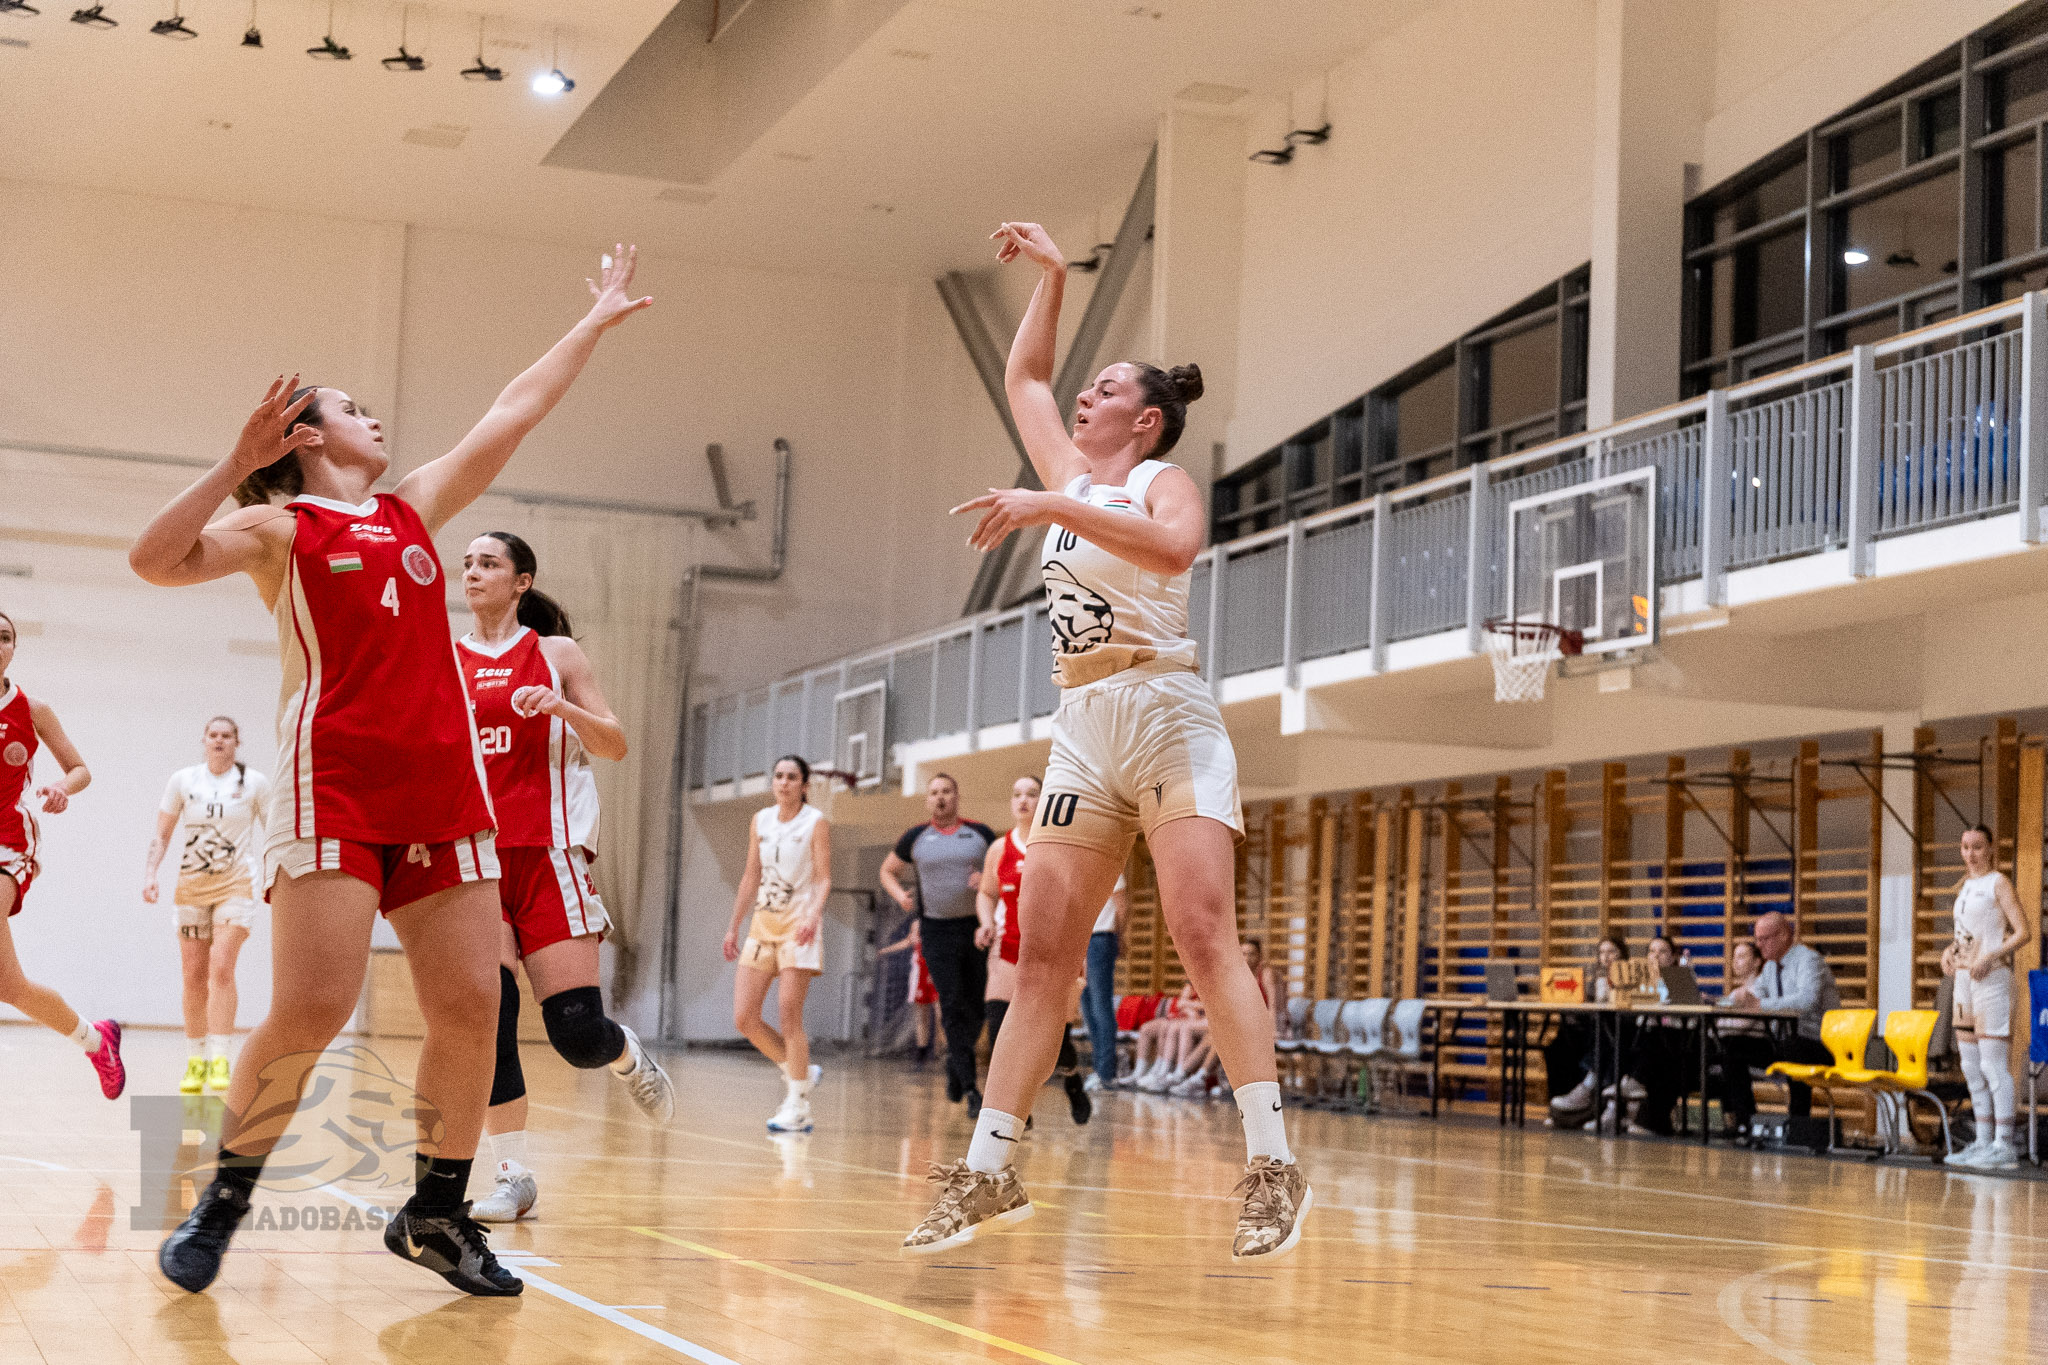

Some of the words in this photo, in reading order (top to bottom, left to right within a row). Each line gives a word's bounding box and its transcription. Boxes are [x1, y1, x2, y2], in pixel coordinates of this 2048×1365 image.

[1056, 527, 1078, 552] 10
[380, 577, 400, 617] 4
[479, 725, 511, 755] 20
[206, 803, 224, 819] 91
[1041, 793, 1079, 827] 10
[406, 842, 432, 868] 4
